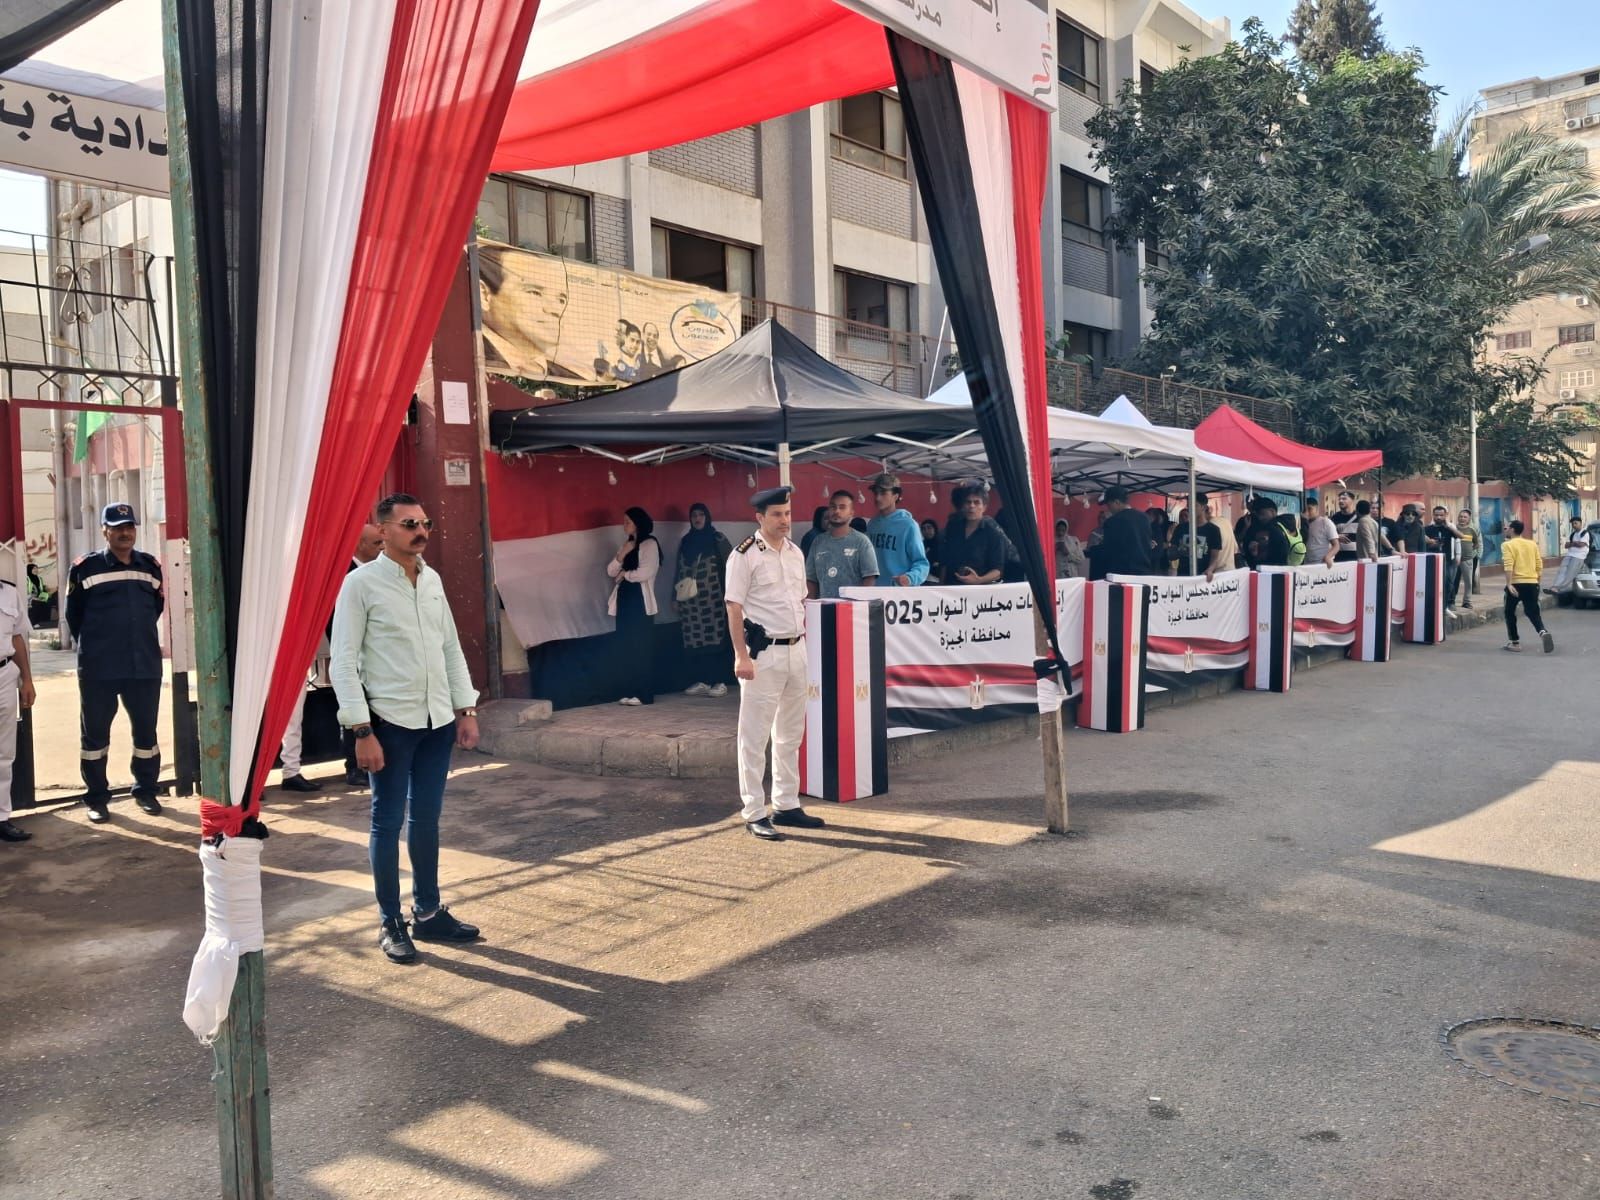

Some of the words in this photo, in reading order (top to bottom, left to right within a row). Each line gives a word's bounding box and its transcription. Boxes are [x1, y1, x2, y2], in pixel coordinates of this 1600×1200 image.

[1161, 584, 1184, 603] النواب
[1186, 584, 1209, 602] مجلس
[885, 599, 923, 625] 025
[928, 597, 968, 622] النواب
[972, 595, 1013, 619] مجلس
[1186, 608, 1209, 621] محافظة
[940, 631, 968, 650] الجيزة
[971, 625, 1011, 643] محافظة
